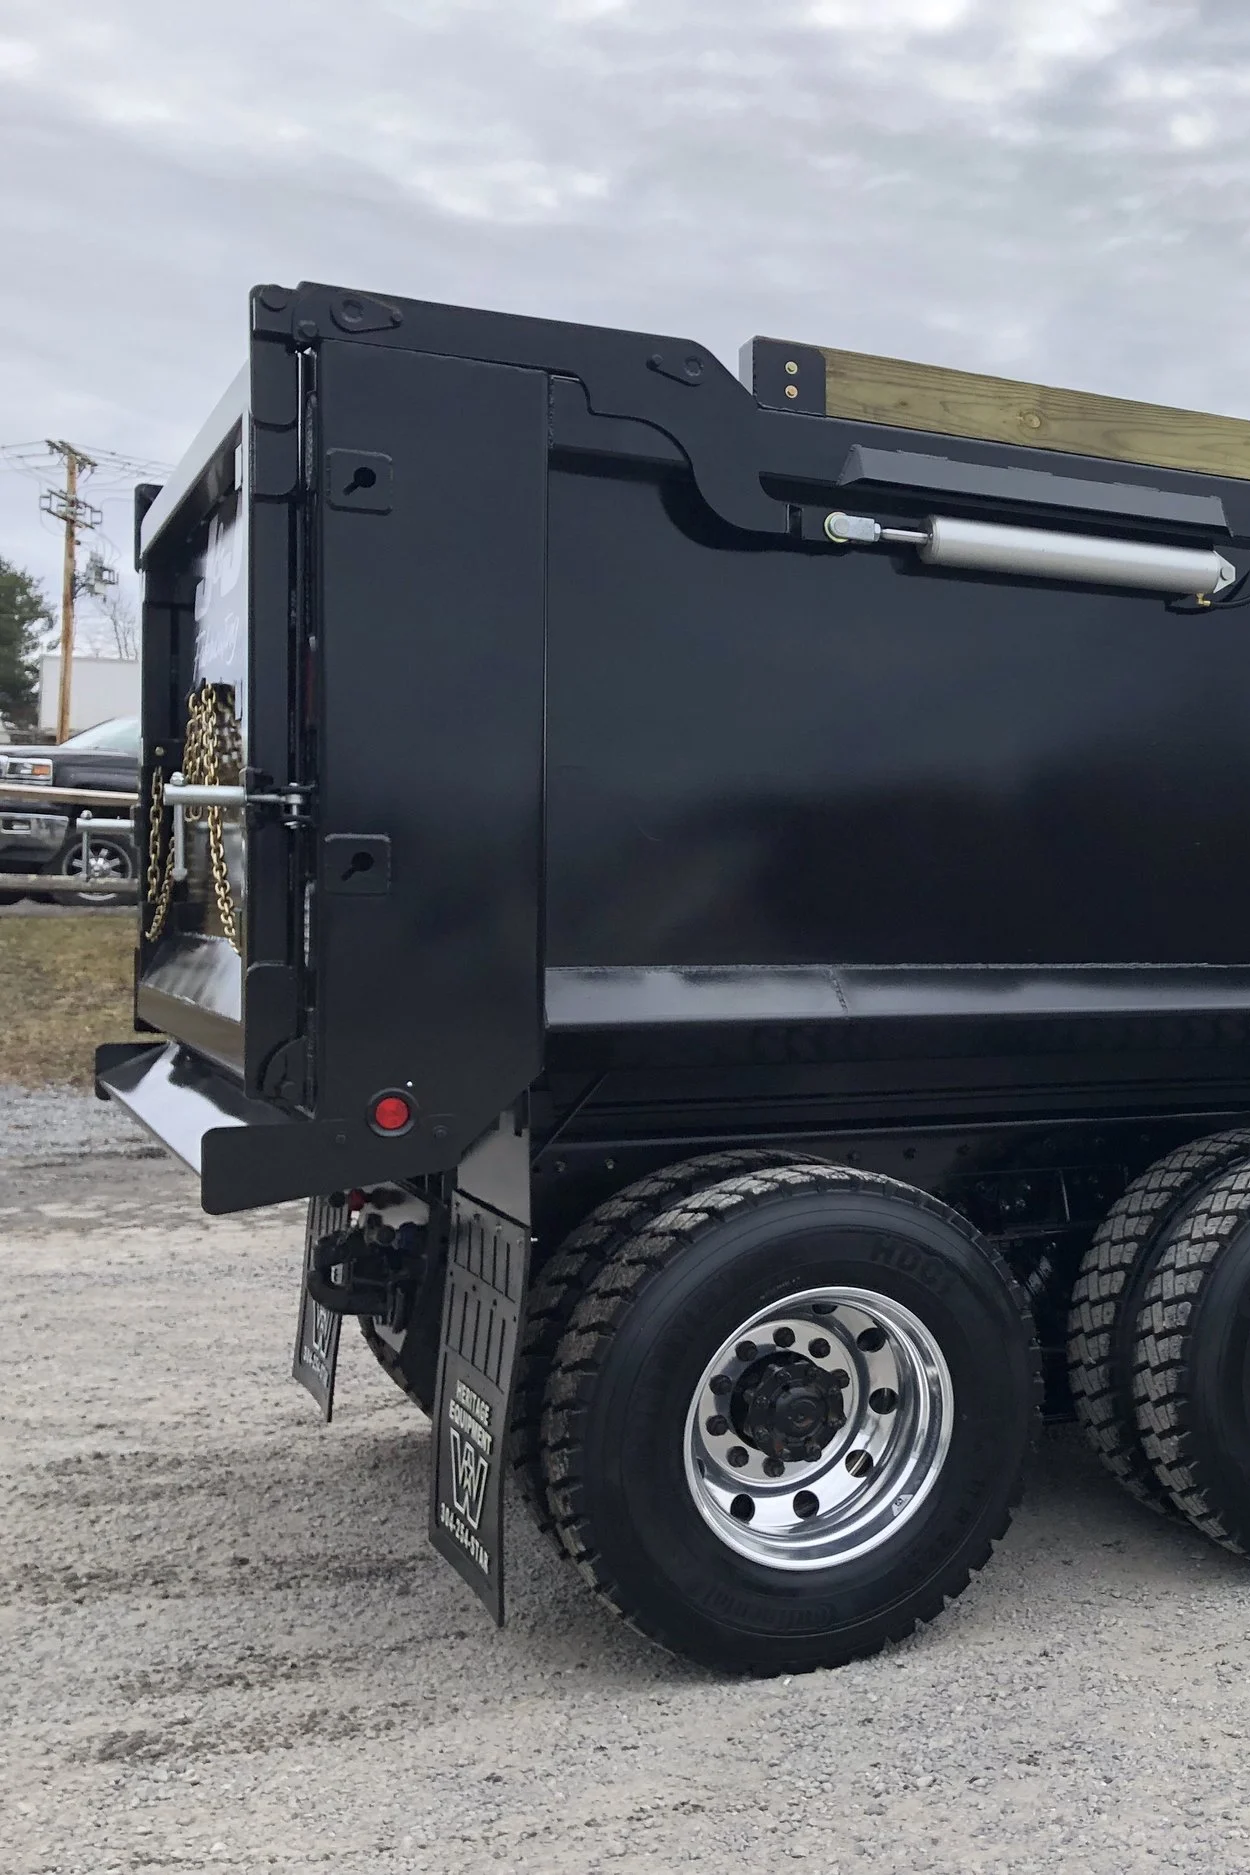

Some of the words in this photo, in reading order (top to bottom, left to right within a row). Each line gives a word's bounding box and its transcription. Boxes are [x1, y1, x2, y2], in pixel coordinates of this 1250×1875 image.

[450, 1399, 493, 1455] EQUIPMENT
[456, 1379, 490, 1426] HERITAGE
[441, 1502, 489, 1575] 304-254-STAR
